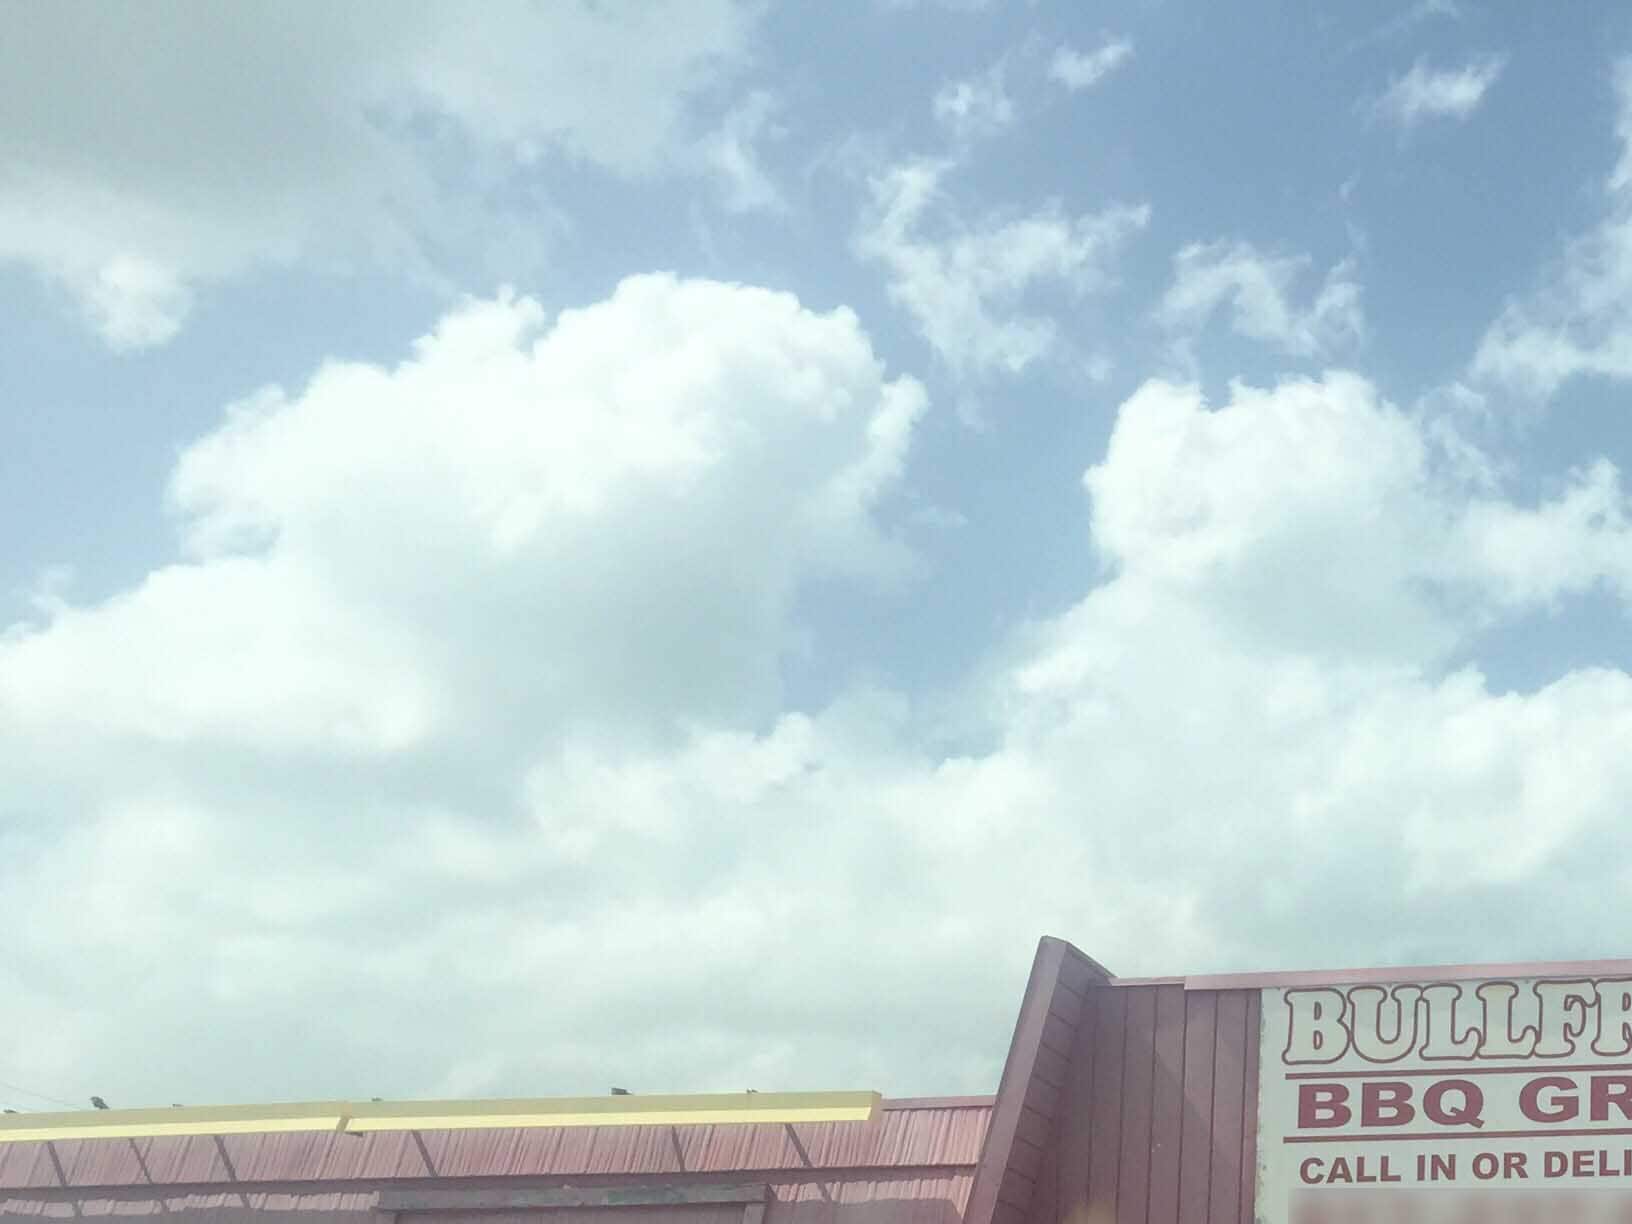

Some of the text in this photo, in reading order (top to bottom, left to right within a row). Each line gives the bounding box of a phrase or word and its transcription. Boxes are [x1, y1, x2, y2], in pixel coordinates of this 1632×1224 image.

[1297, 1079, 1485, 1129] BBQ
[1299, 1155, 1401, 1184] CALL
[1416, 1154, 1457, 1182] IN
[1471, 1151, 1529, 1180] OR
